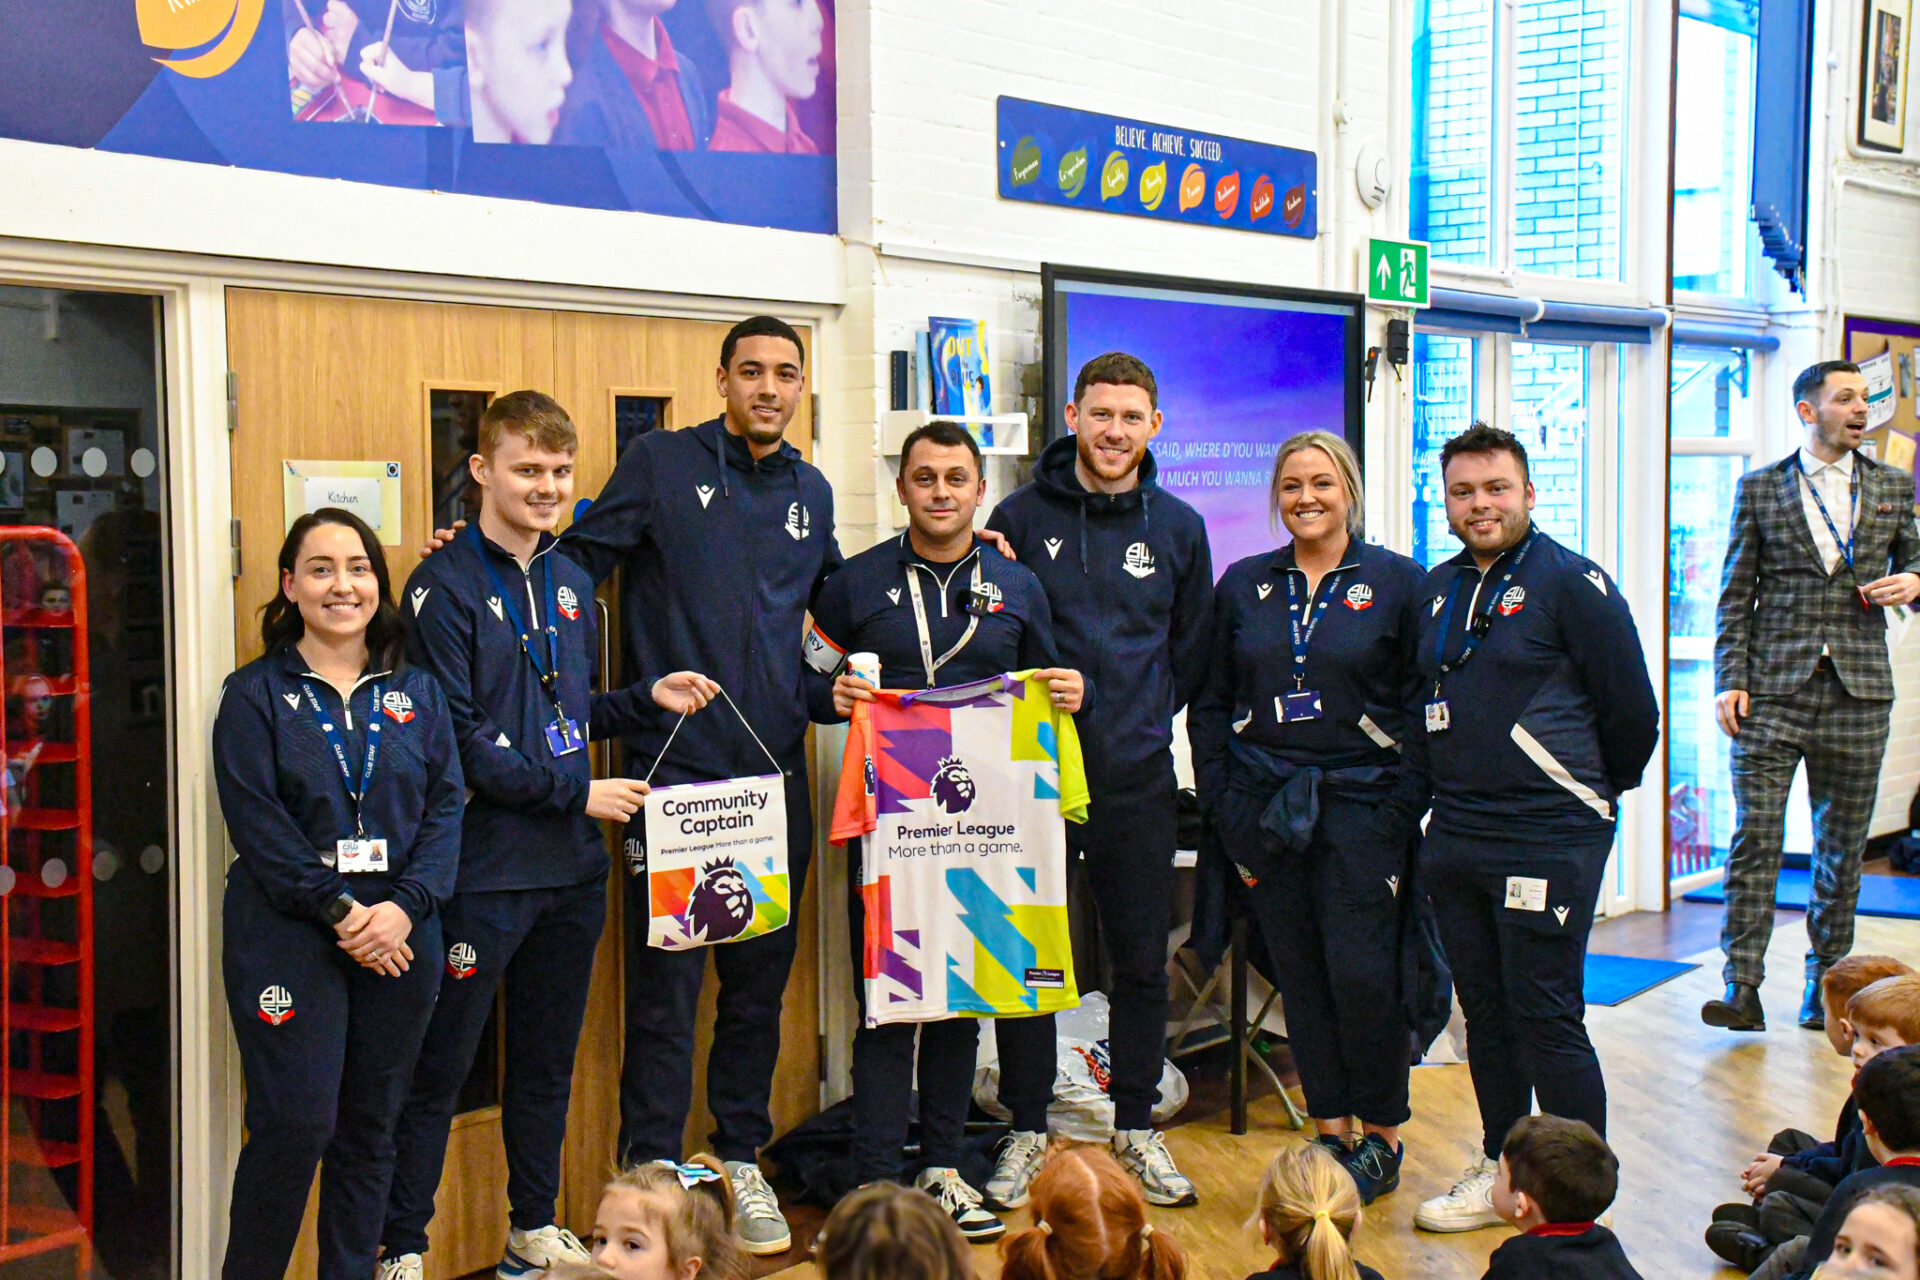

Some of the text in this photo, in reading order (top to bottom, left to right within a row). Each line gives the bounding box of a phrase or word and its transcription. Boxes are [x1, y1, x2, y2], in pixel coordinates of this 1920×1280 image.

[1115, 125, 1223, 163] BELIEVE. ACHIEVE. SUCCEED.
[947, 336, 972, 357] OUT
[1155, 442, 1181, 460] SAID,
[1185, 442, 1221, 458] WHERE
[1223, 442, 1253, 458] D'YOU
[1255, 442, 1281, 458] WAN
[1167, 471, 1199, 487] MUCH
[1202, 471, 1223, 487] YOU
[1225, 471, 1262, 487] WANNA
[328, 491, 359, 504] Kitchen
[806, 631, 825, 652] nity
[303, 684, 323, 712] CLUB STAFF
[334, 743, 351, 778] CLUB STAFF
[364, 744, 376, 778] CLUB STAFF
[662, 789, 768, 817] Community
[680, 811, 754, 836] Captain
[897, 820, 1015, 840] Premier League
[660, 846, 688, 855] Premier
[689, 842, 715, 853] League
[715, 840, 732, 849] More
[733, 837, 748, 846] than
[754, 835, 774, 845] game.
[888, 841, 1023, 859] More than a game.
